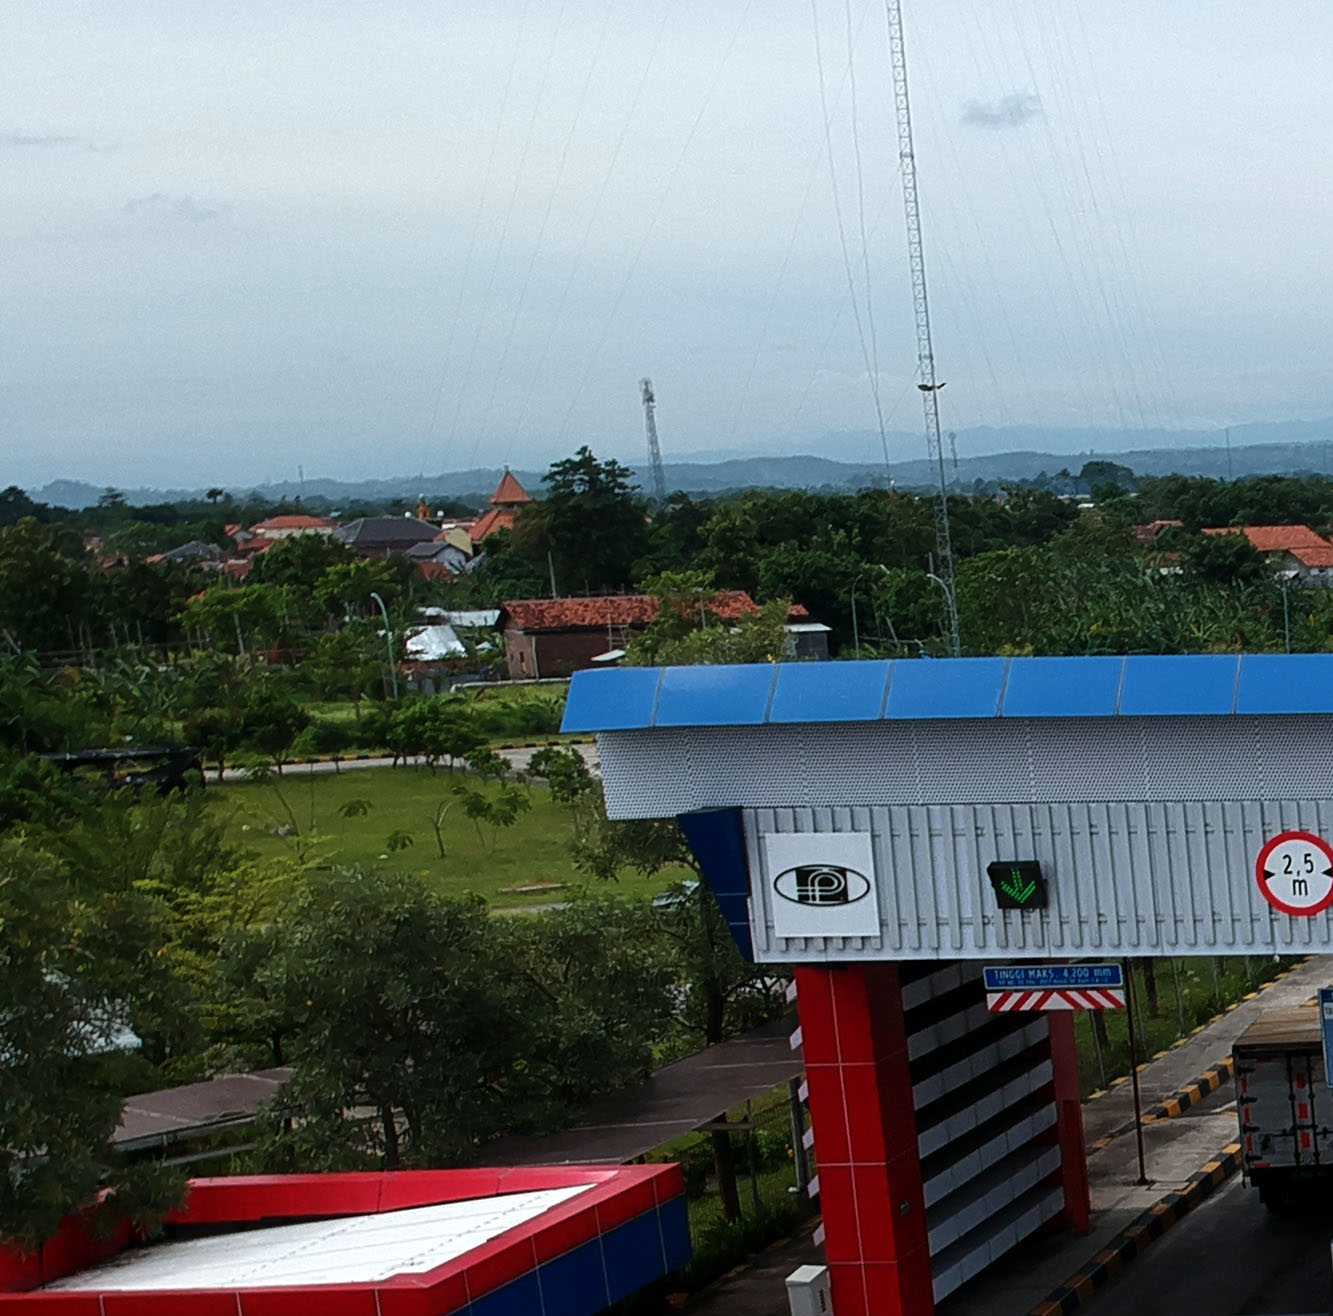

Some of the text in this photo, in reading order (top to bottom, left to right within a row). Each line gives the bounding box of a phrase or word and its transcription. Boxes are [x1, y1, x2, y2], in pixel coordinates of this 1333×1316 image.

[1282, 853, 1314, 877] 2,5
[1292, 879, 1308, 896] m
[994, 969, 1024, 980] TINGGI
[1094, 968, 1112, 977] mm
